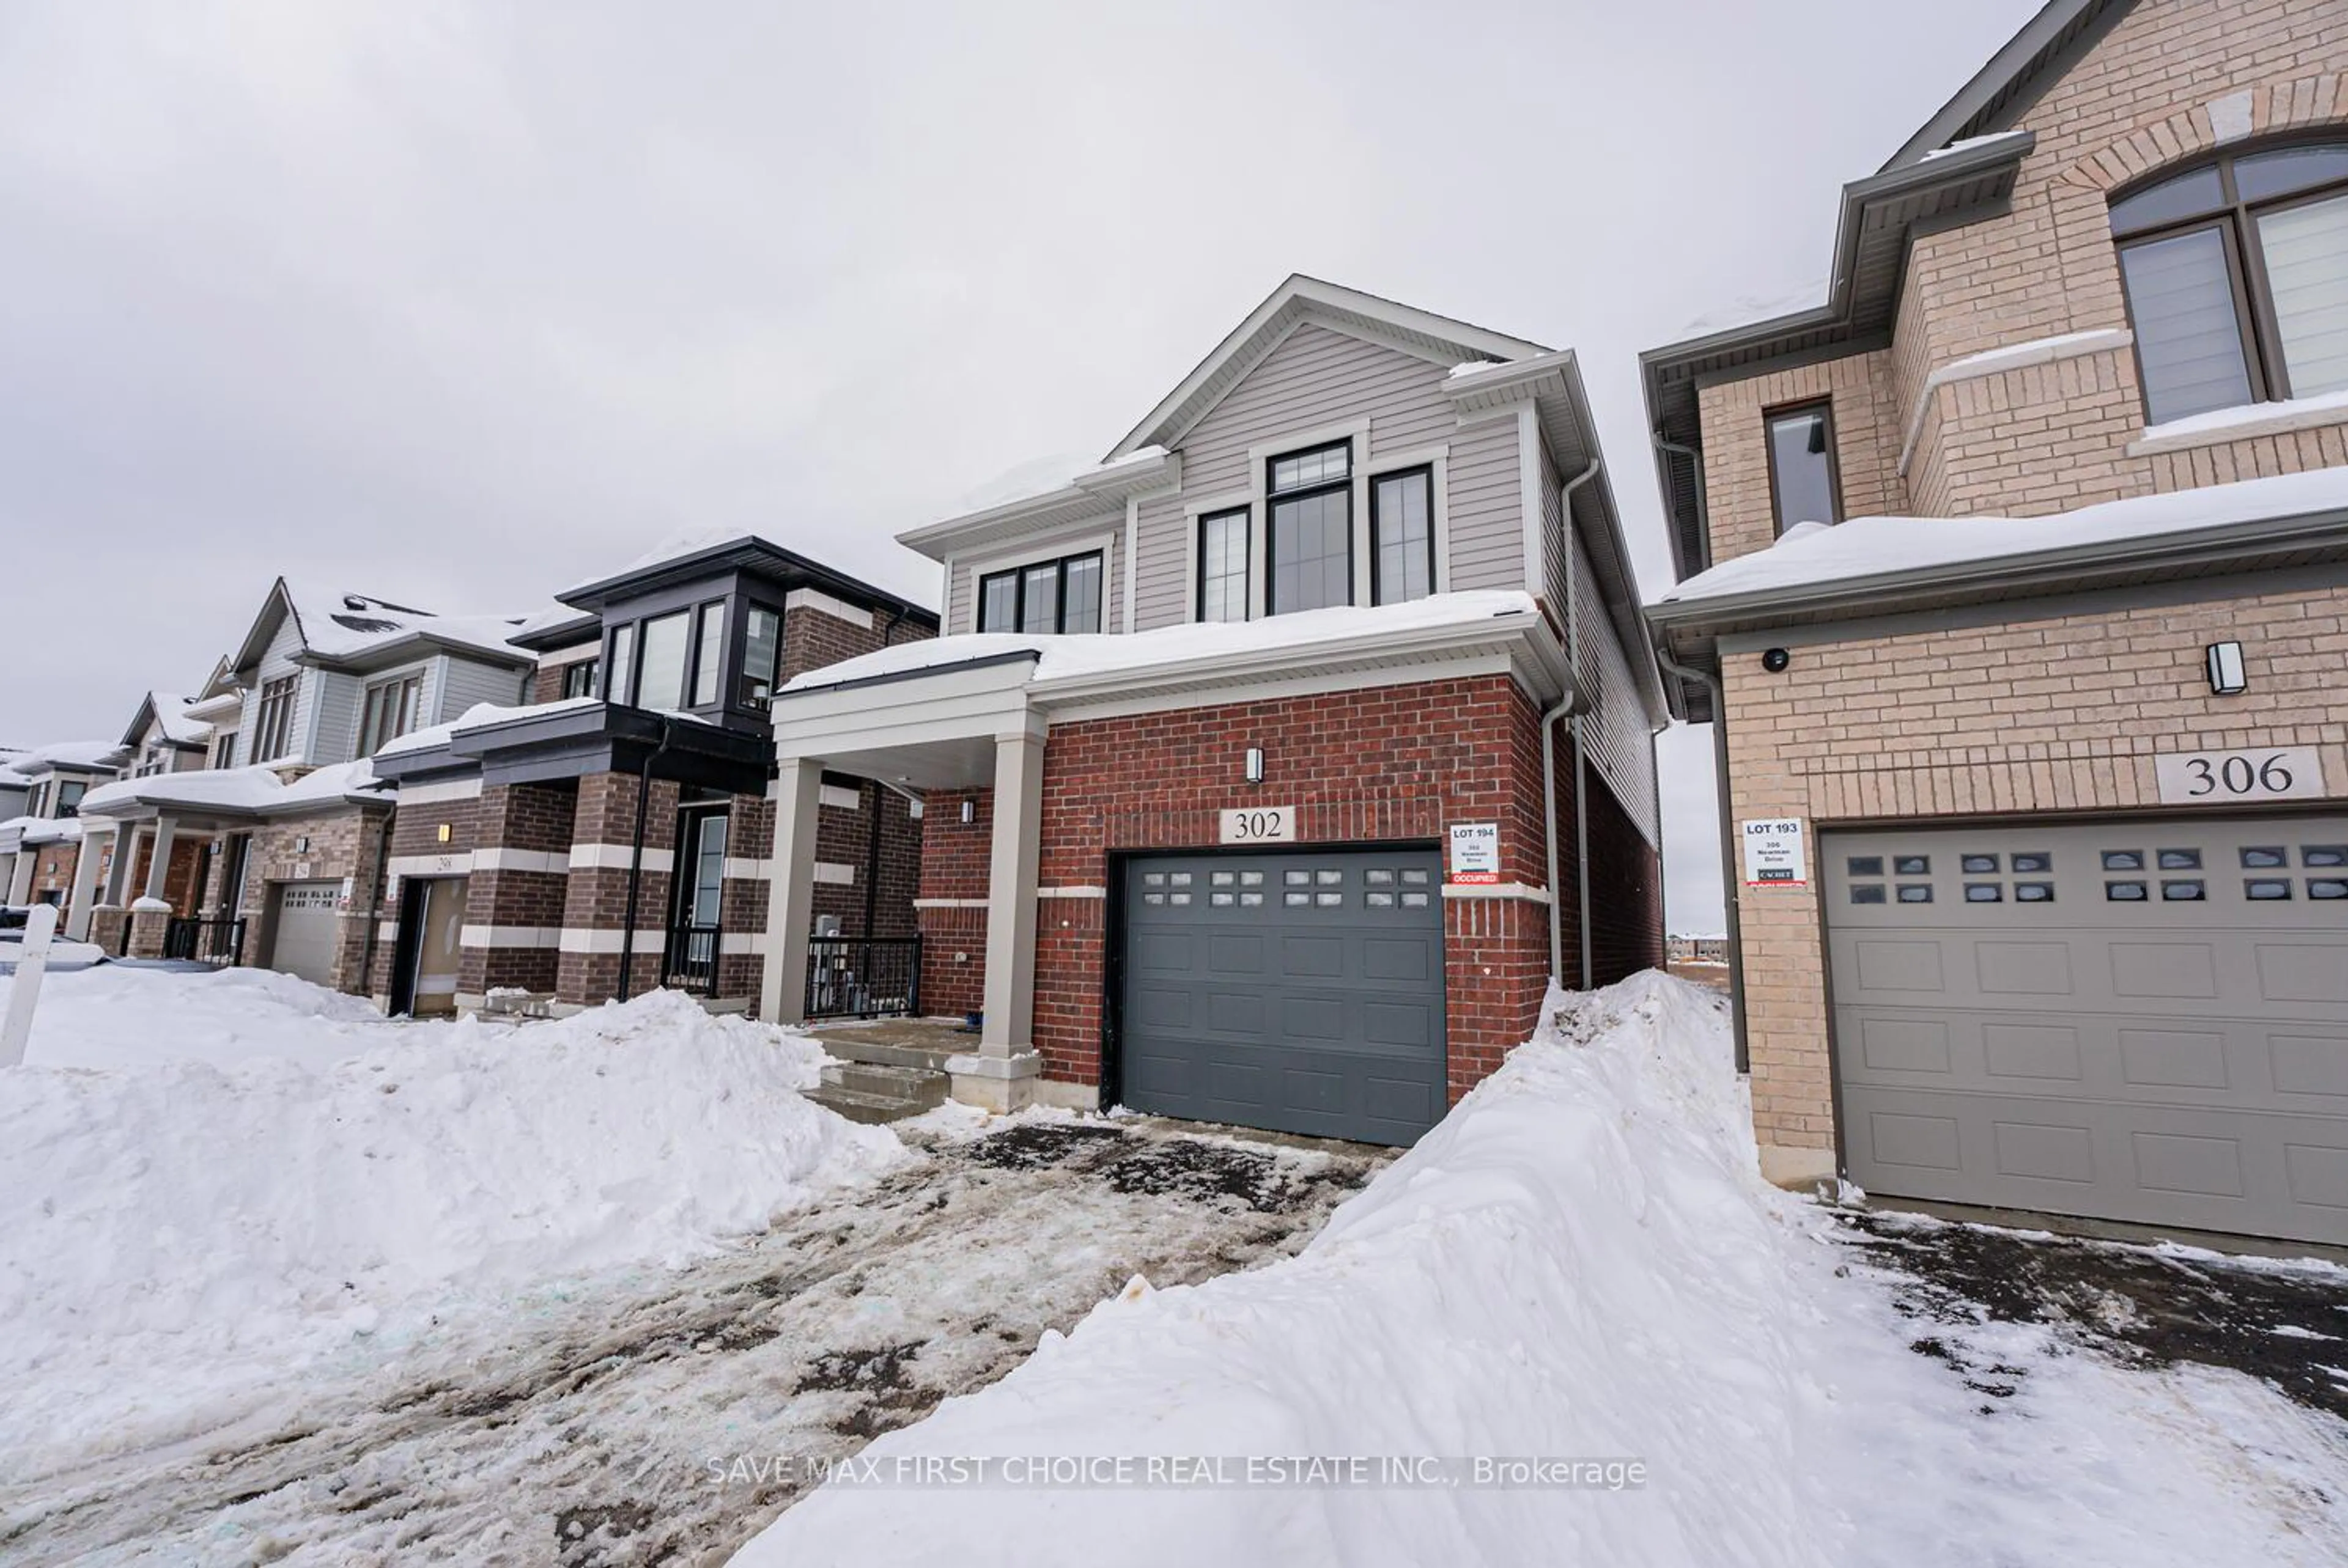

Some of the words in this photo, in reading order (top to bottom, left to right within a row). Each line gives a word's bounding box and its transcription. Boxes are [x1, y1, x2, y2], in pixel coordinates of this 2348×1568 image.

[2186, 753, 2293, 795] 306
[1235, 812, 1281, 838] 302
[1453, 829, 1473, 838] LOT
[1747, 823, 1771, 834] LOT
[1776, 823, 1798, 833] 193
